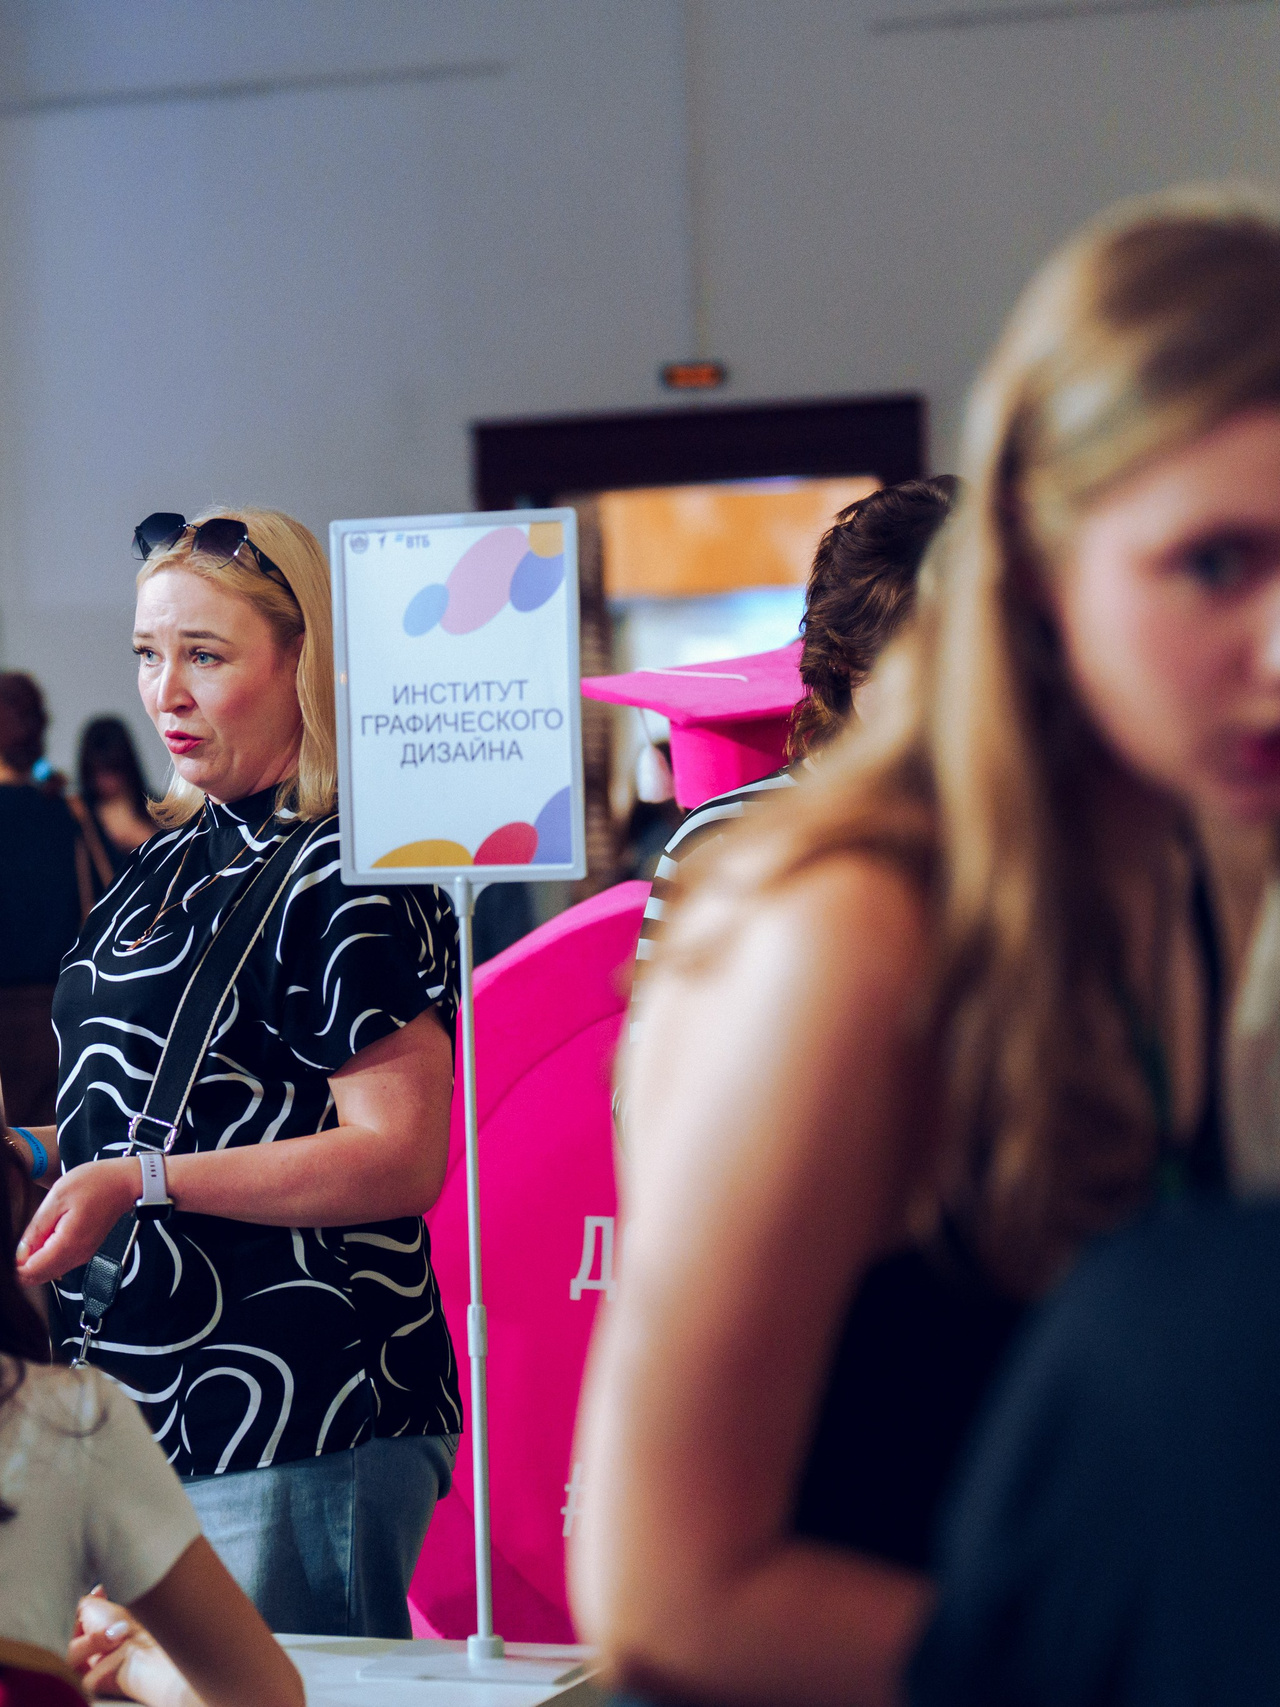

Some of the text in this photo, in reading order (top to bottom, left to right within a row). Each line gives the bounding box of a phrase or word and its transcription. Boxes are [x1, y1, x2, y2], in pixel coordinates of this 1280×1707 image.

[405, 534, 431, 549] ВТБ
[392, 679, 529, 706] ИНСТИТУТ
[360, 707, 564, 736] ГРАФИЧЕСКОГО
[400, 736, 524, 769] ДИЗАЙНА
